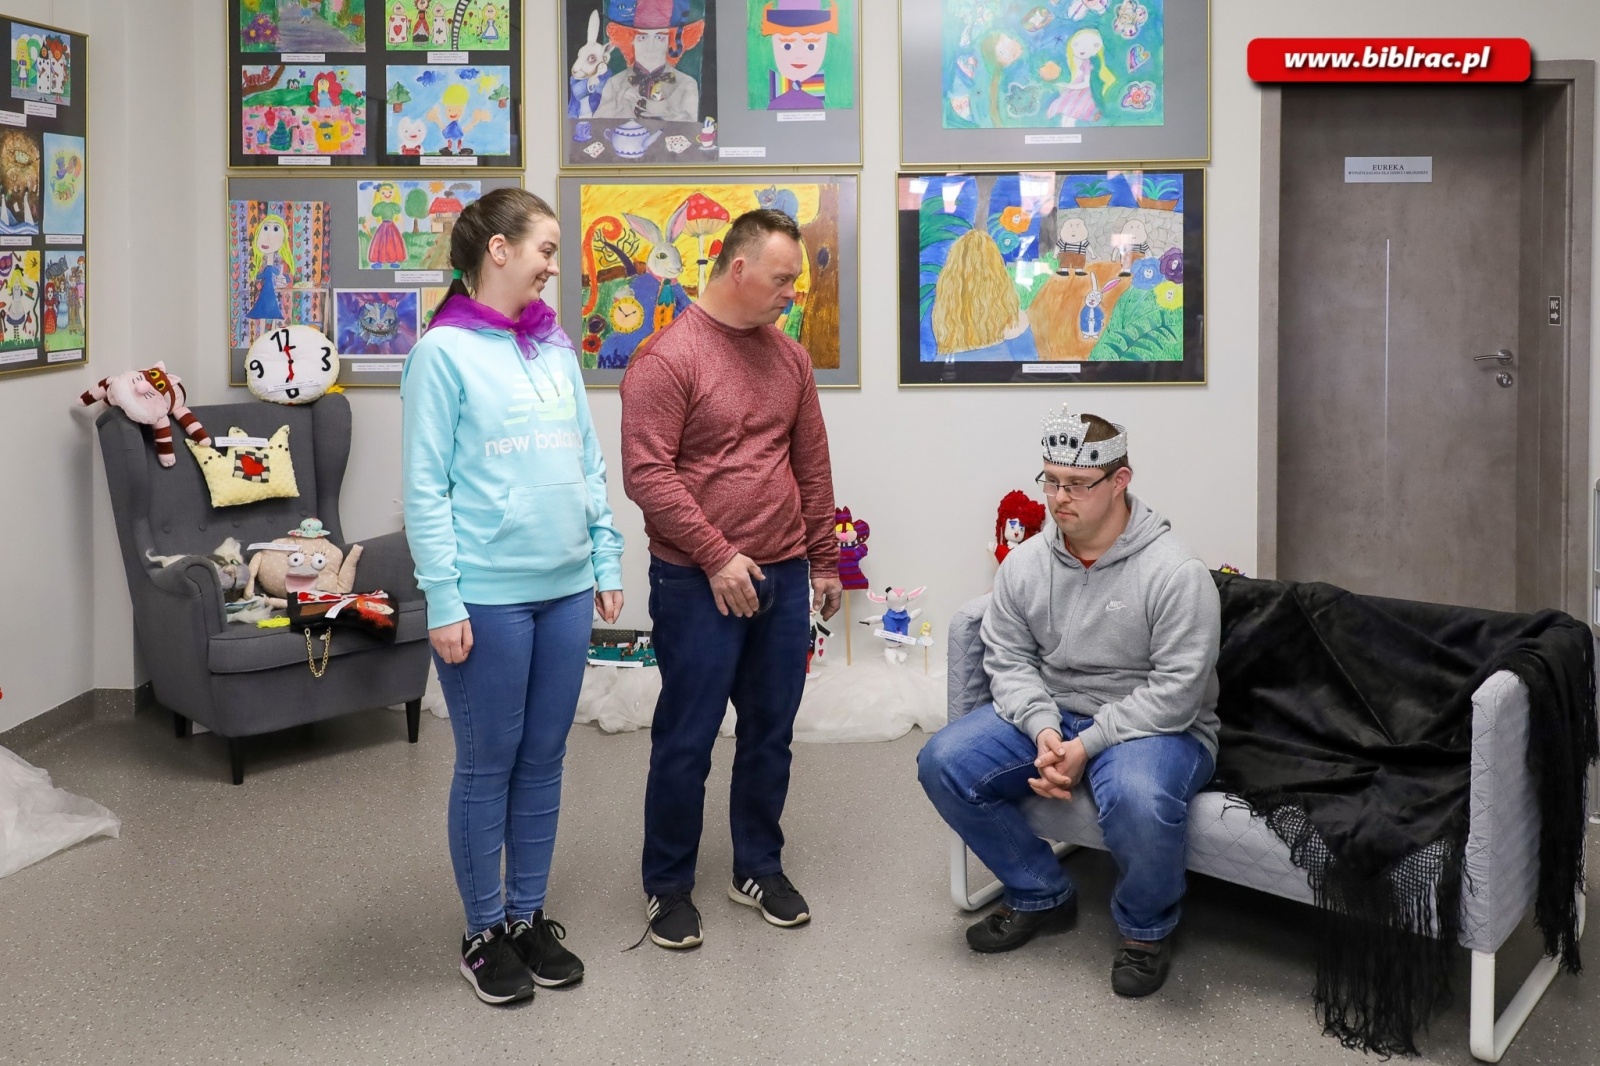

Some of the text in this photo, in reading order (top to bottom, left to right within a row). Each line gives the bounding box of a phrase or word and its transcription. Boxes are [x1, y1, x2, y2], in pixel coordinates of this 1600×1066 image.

[1550, 300, 1559, 310] WC
[270, 329, 296, 352] 12
[249, 359, 264, 378] 9
[321, 346, 331, 372] 3
[484, 434, 530, 457] new
